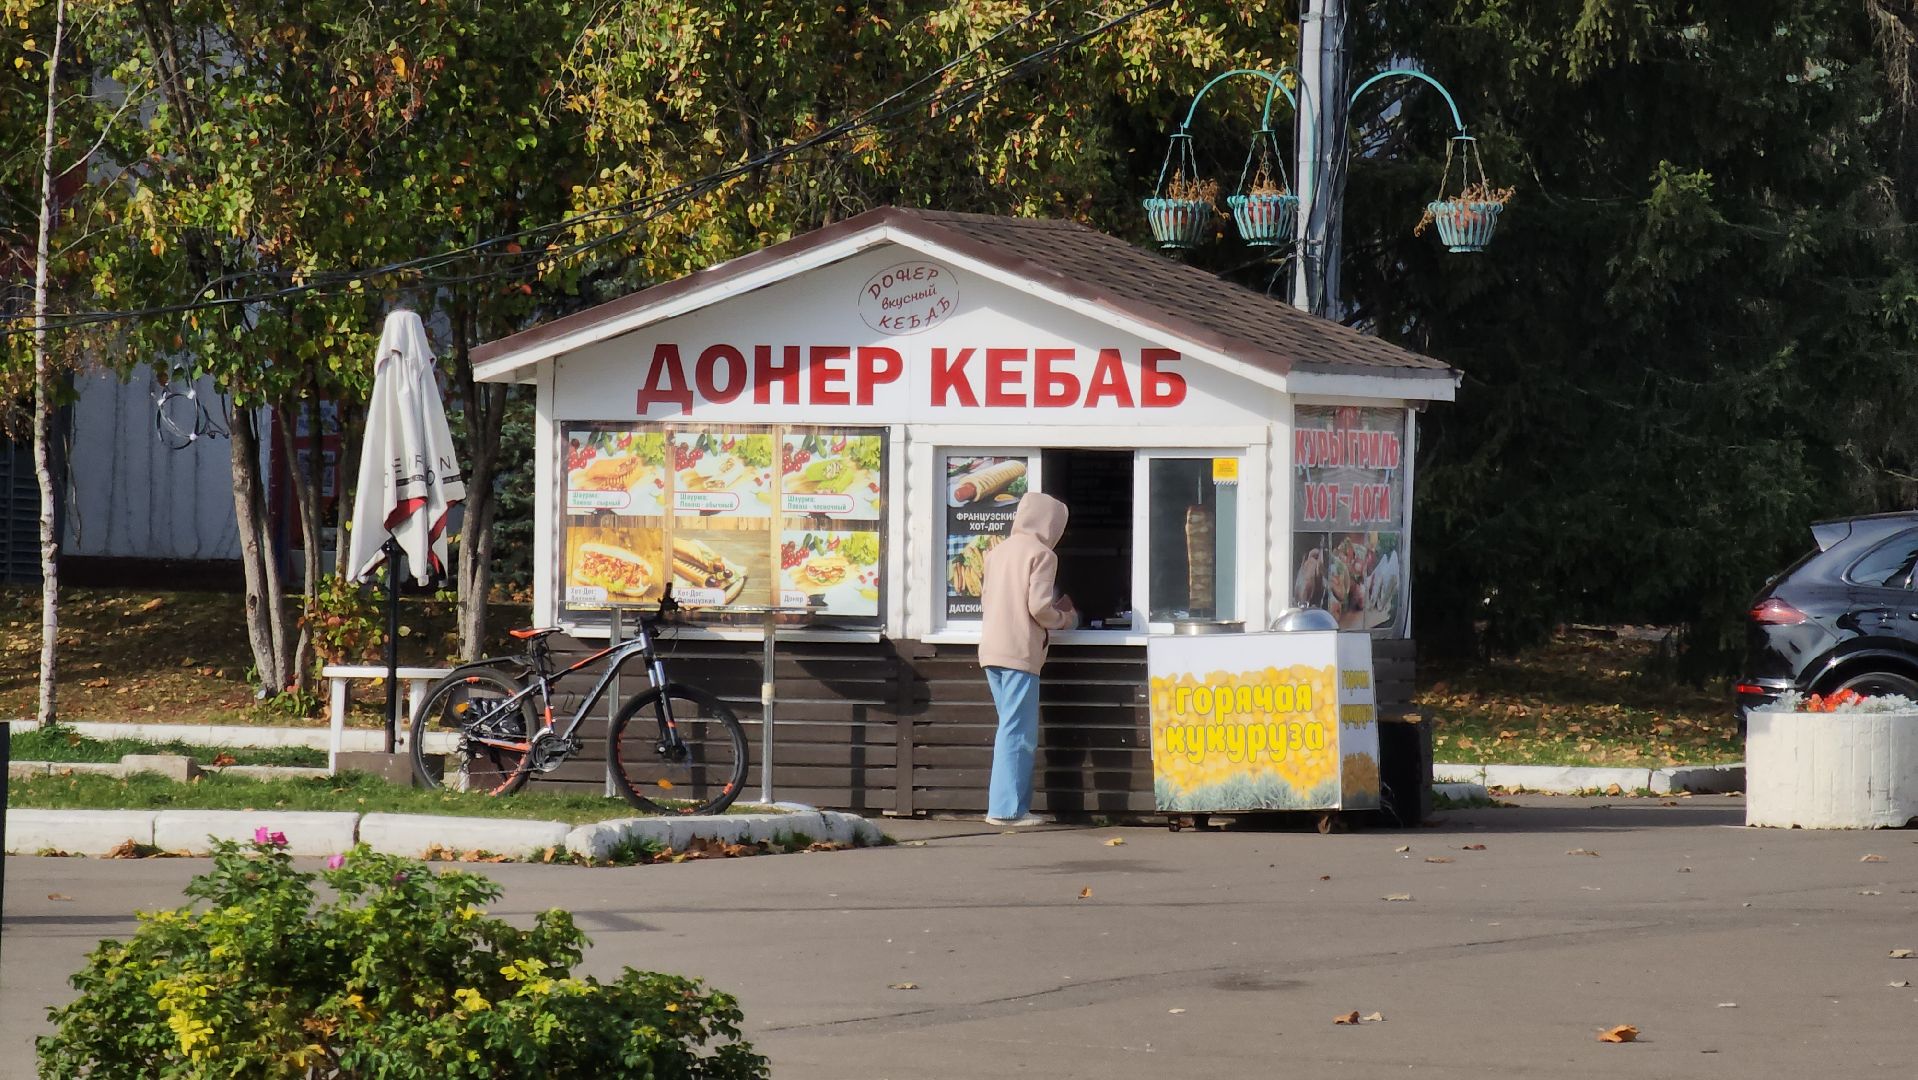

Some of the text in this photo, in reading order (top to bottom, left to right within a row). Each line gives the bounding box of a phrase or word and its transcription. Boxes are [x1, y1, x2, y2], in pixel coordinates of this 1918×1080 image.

[879, 297, 950, 329] КЕБАБ
[881, 284, 936, 310] вкусный
[637, 344, 1188, 415] ДОНЕР КЕБАБ
[1294, 428, 1401, 470] КУРЫ ГРИЛЬ
[1304, 482, 1391, 526] ХОТ-ДОГИ
[969, 523, 1006, 532] ХОТ-ДОГ
[948, 604, 984, 614] ДАТСКИ
[1175, 684, 1313, 724] горячая
[1166, 721, 1326, 764] кукуруза
